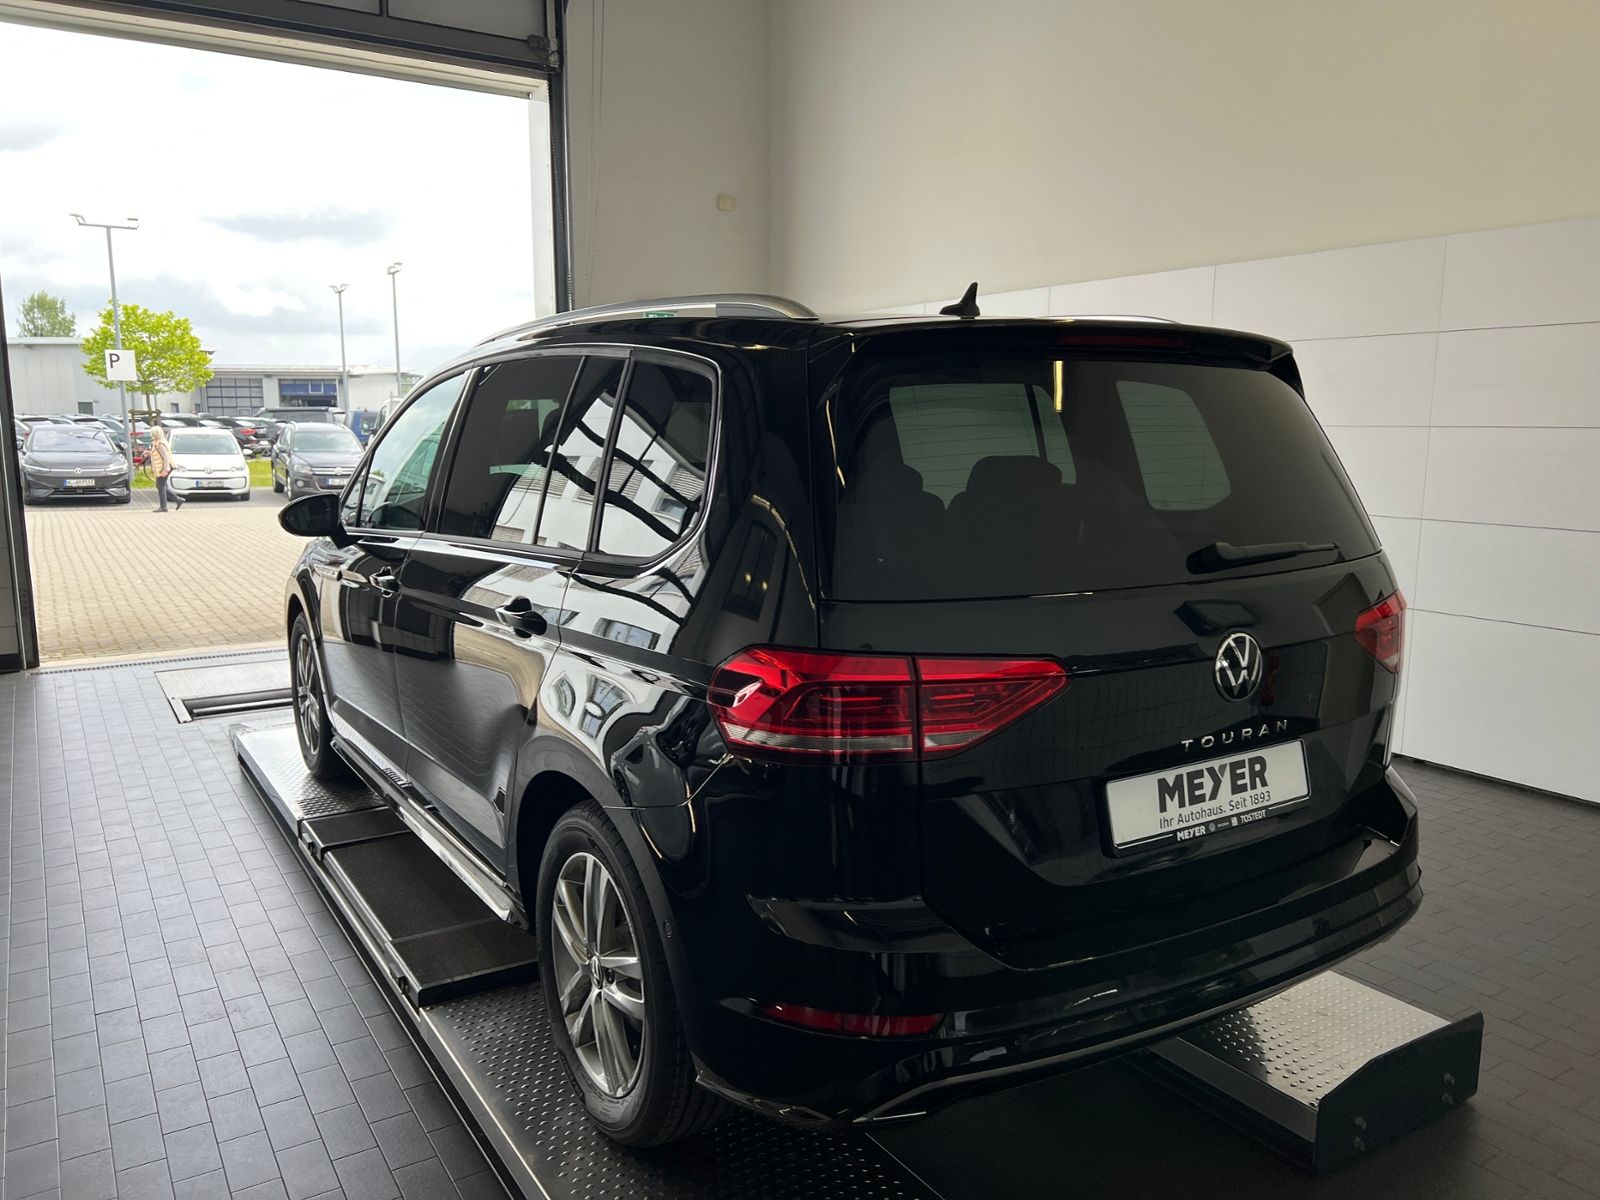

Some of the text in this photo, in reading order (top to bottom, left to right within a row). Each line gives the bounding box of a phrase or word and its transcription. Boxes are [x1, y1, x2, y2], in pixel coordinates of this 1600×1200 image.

[109, 353, 120, 368] P
[1181, 719, 1288, 752] TOURAN
[1157, 756, 1268, 813] MEYER
[1159, 816, 1174, 830] Ihr
[1177, 807, 1226, 825] Autohaus.
[1229, 797, 1247, 812] Seit
[1250, 791, 1271, 806] 1893
[1176, 809, 1267, 841] MEYER TOSTEDT
